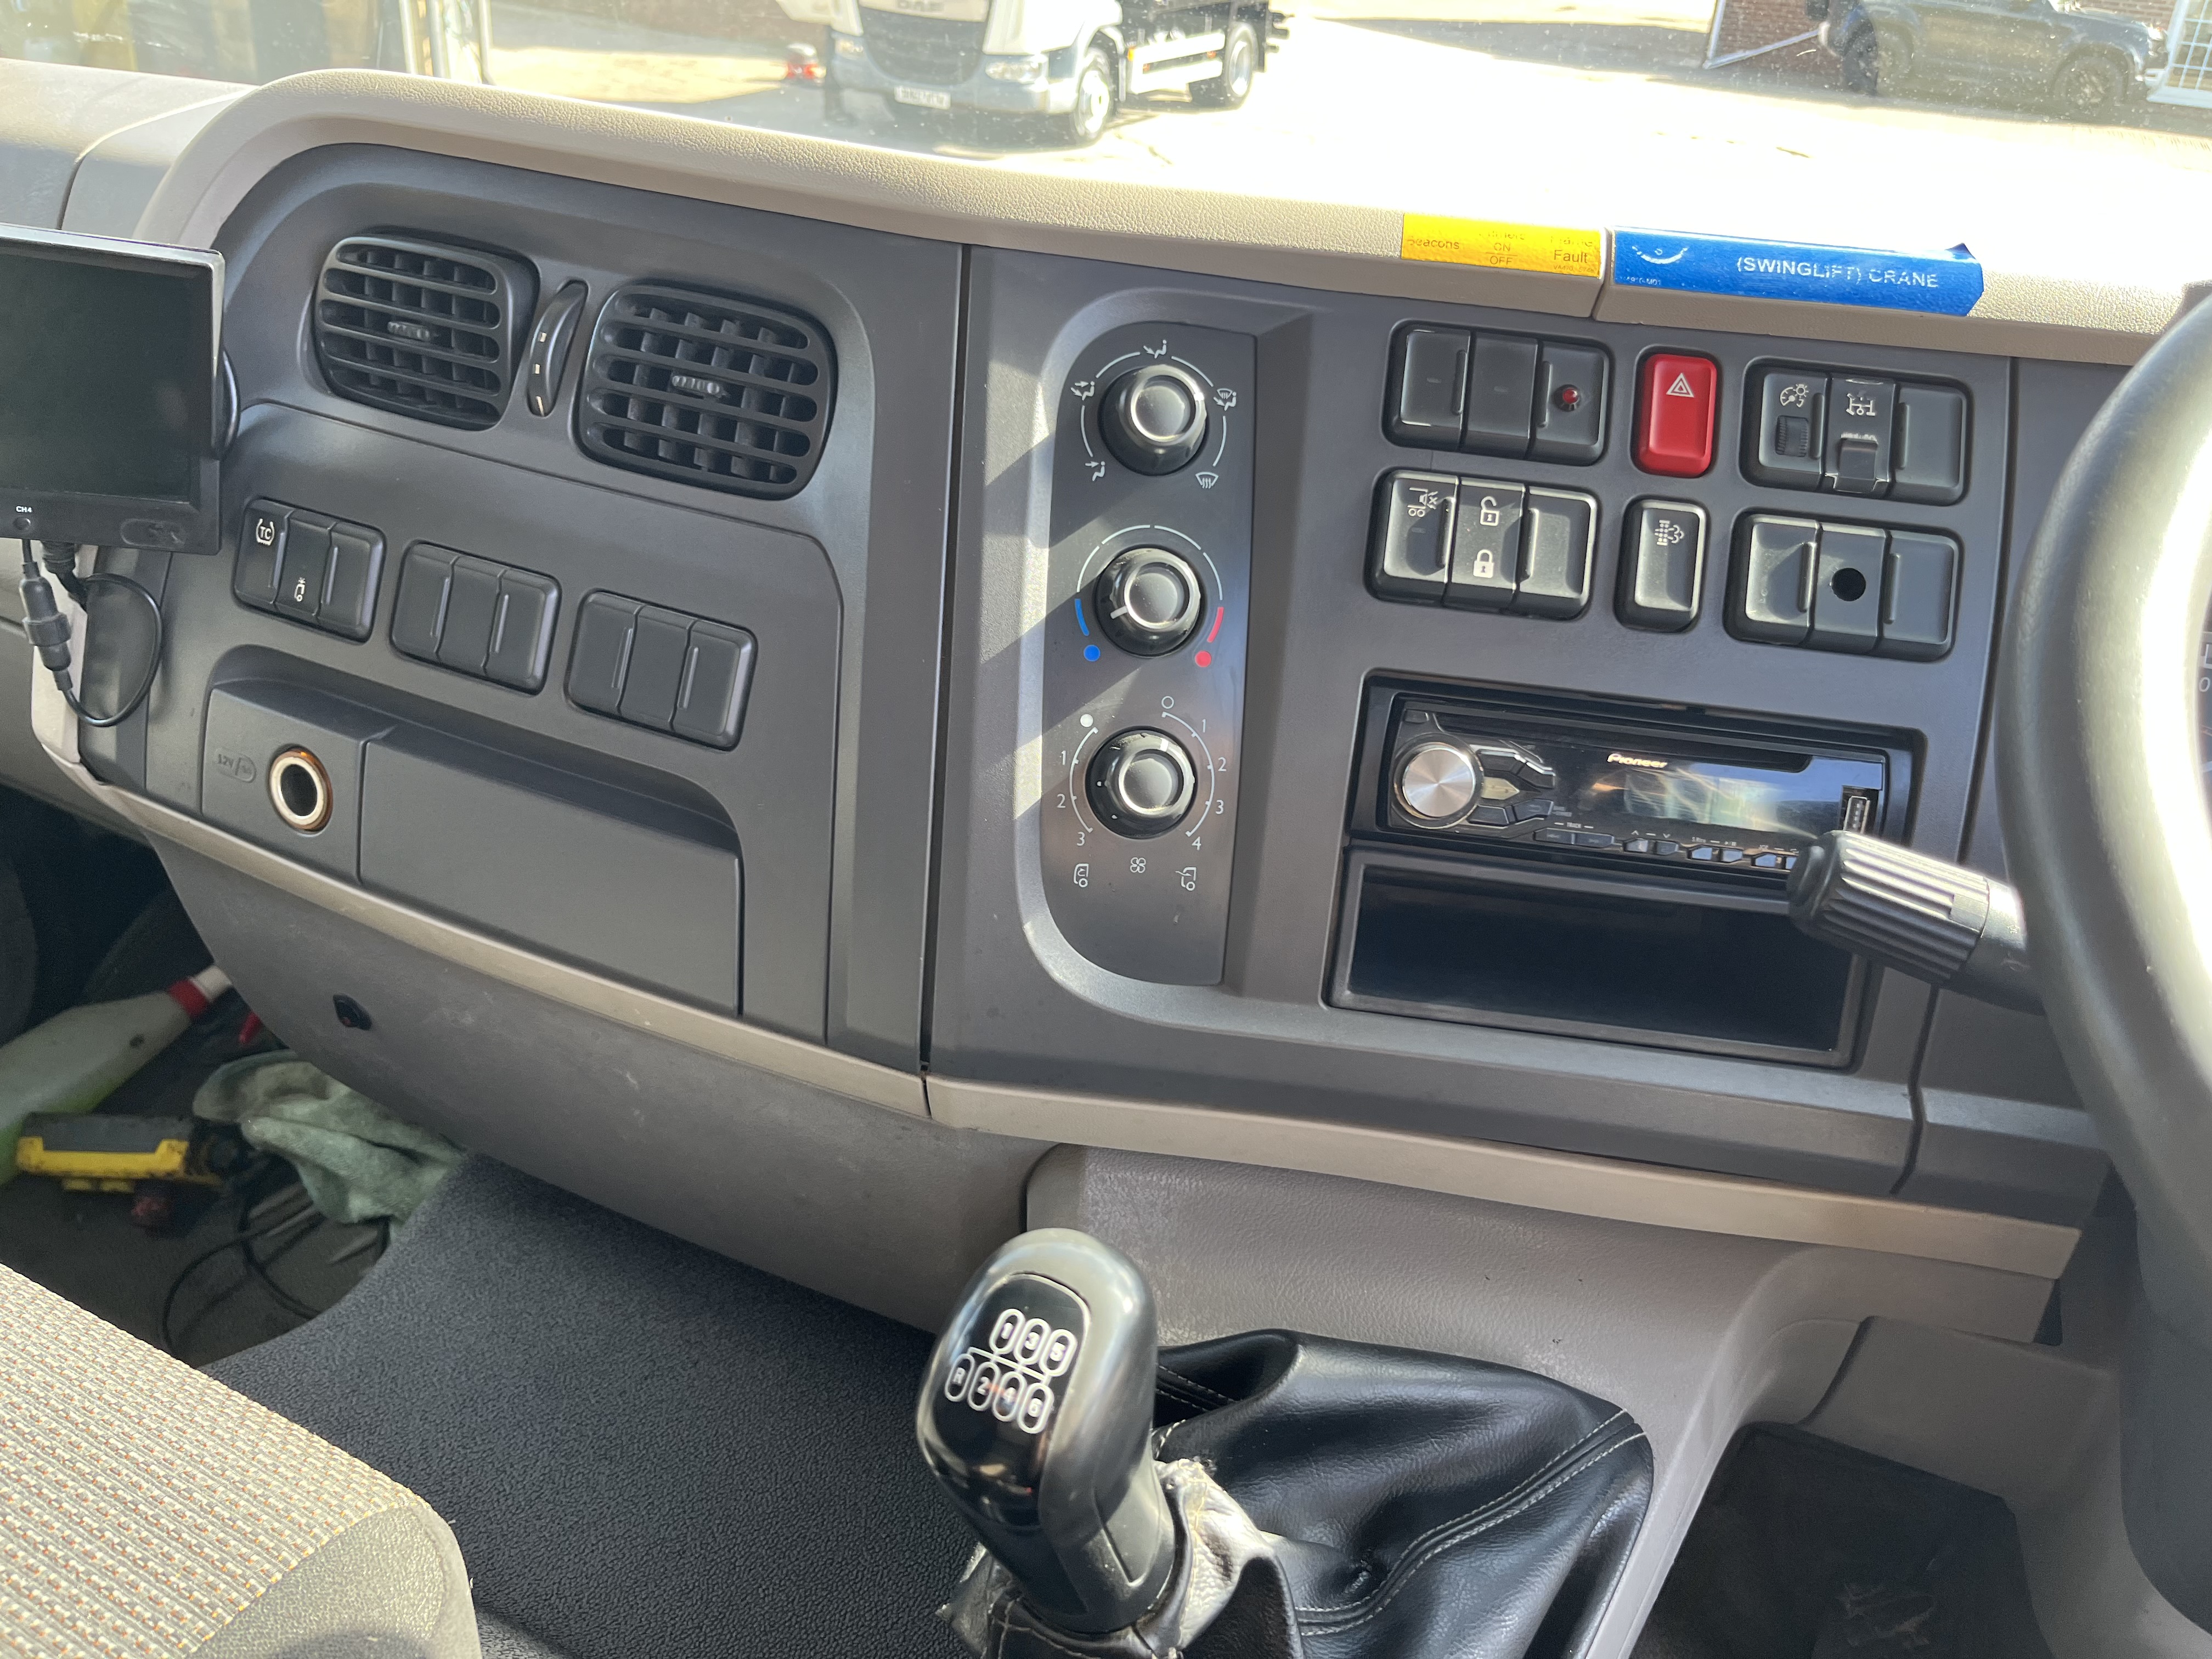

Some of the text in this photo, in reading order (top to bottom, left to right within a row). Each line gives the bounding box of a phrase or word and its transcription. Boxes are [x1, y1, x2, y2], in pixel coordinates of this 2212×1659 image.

[1493, 242, 1511, 252] ON
[1489, 256, 1513, 266] OFF
[1553, 250, 1588, 264] Fault
[1869, 269, 1939, 288] CRANE
[259, 526, 272, 540] TC
[1202, 719, 1206, 733] 1
[1060, 750, 1066, 765] 1
[1218, 757, 1227, 772] 2
[1607, 753, 1668, 768] Pioneer
[1057, 793, 1066, 808] 2
[1215, 800, 1224, 814] 3
[1076, 832, 1085, 846] 3
[1192, 836, 1201, 850] 4
[1001, 1322, 1066, 1362] 1 3 5
[952, 1367, 1043, 1418] R 2 4 6
